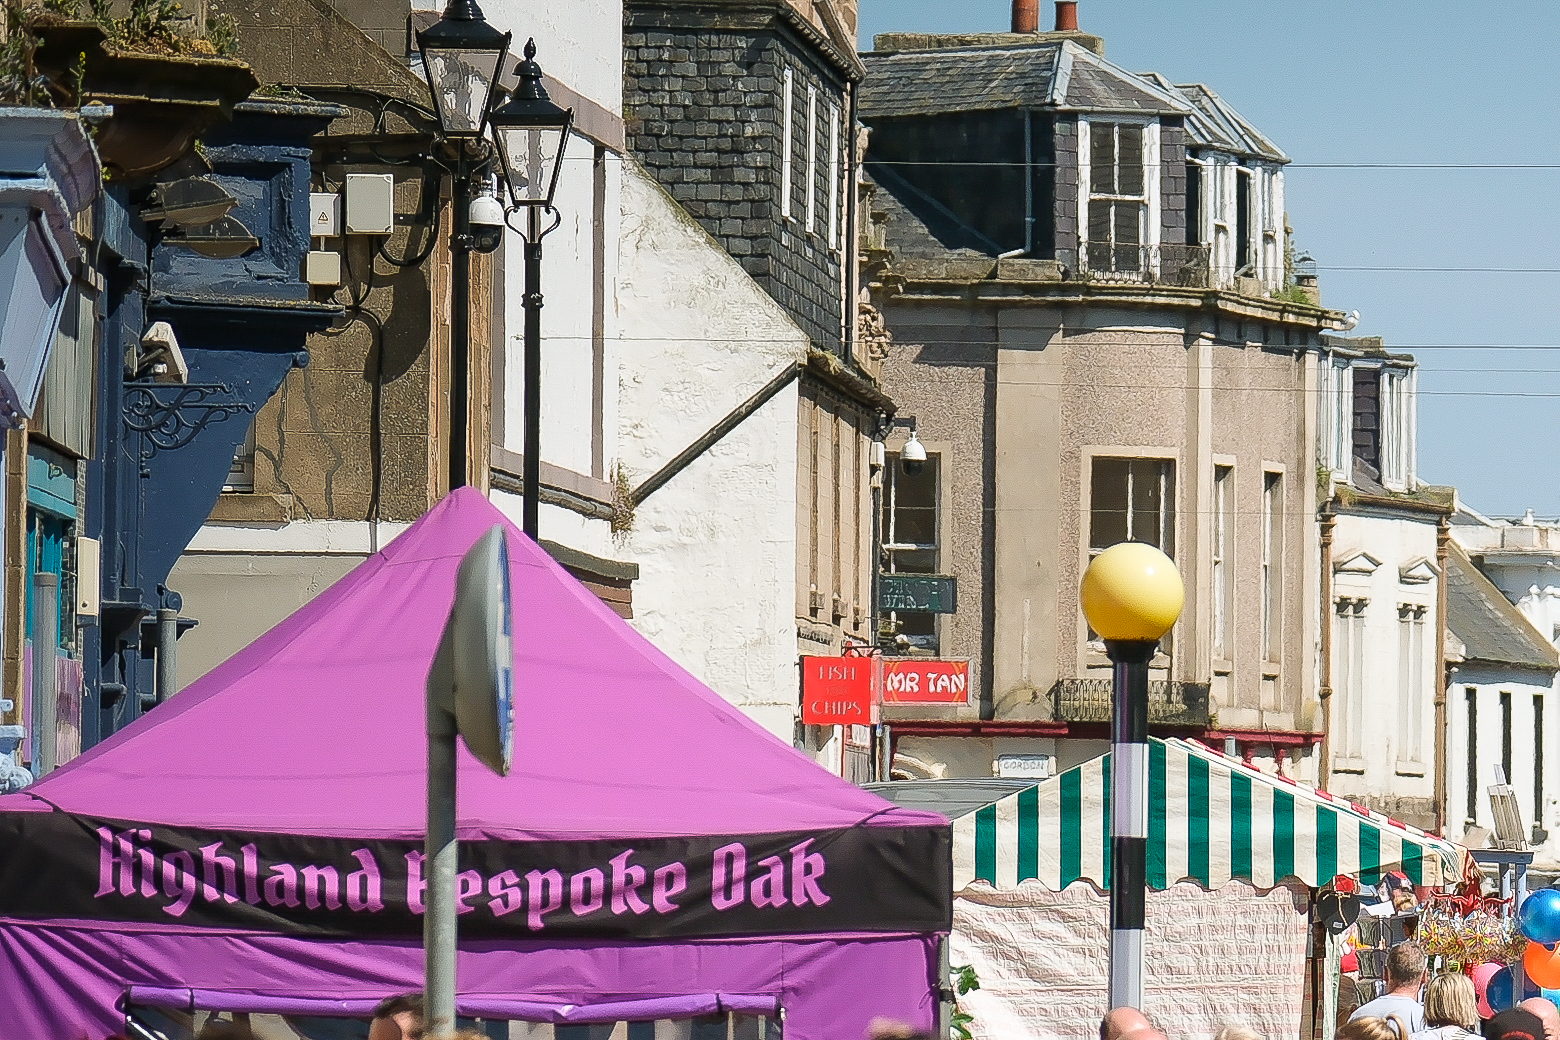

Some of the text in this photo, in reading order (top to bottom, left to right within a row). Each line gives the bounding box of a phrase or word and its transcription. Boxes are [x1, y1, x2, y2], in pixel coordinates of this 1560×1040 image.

[818, 664, 857, 681] FISH
[886, 671, 965, 694] MR TAN
[811, 700, 863, 716] CHIPS
[94, 826, 385, 917] Highland
[711, 837, 832, 911] Oak
